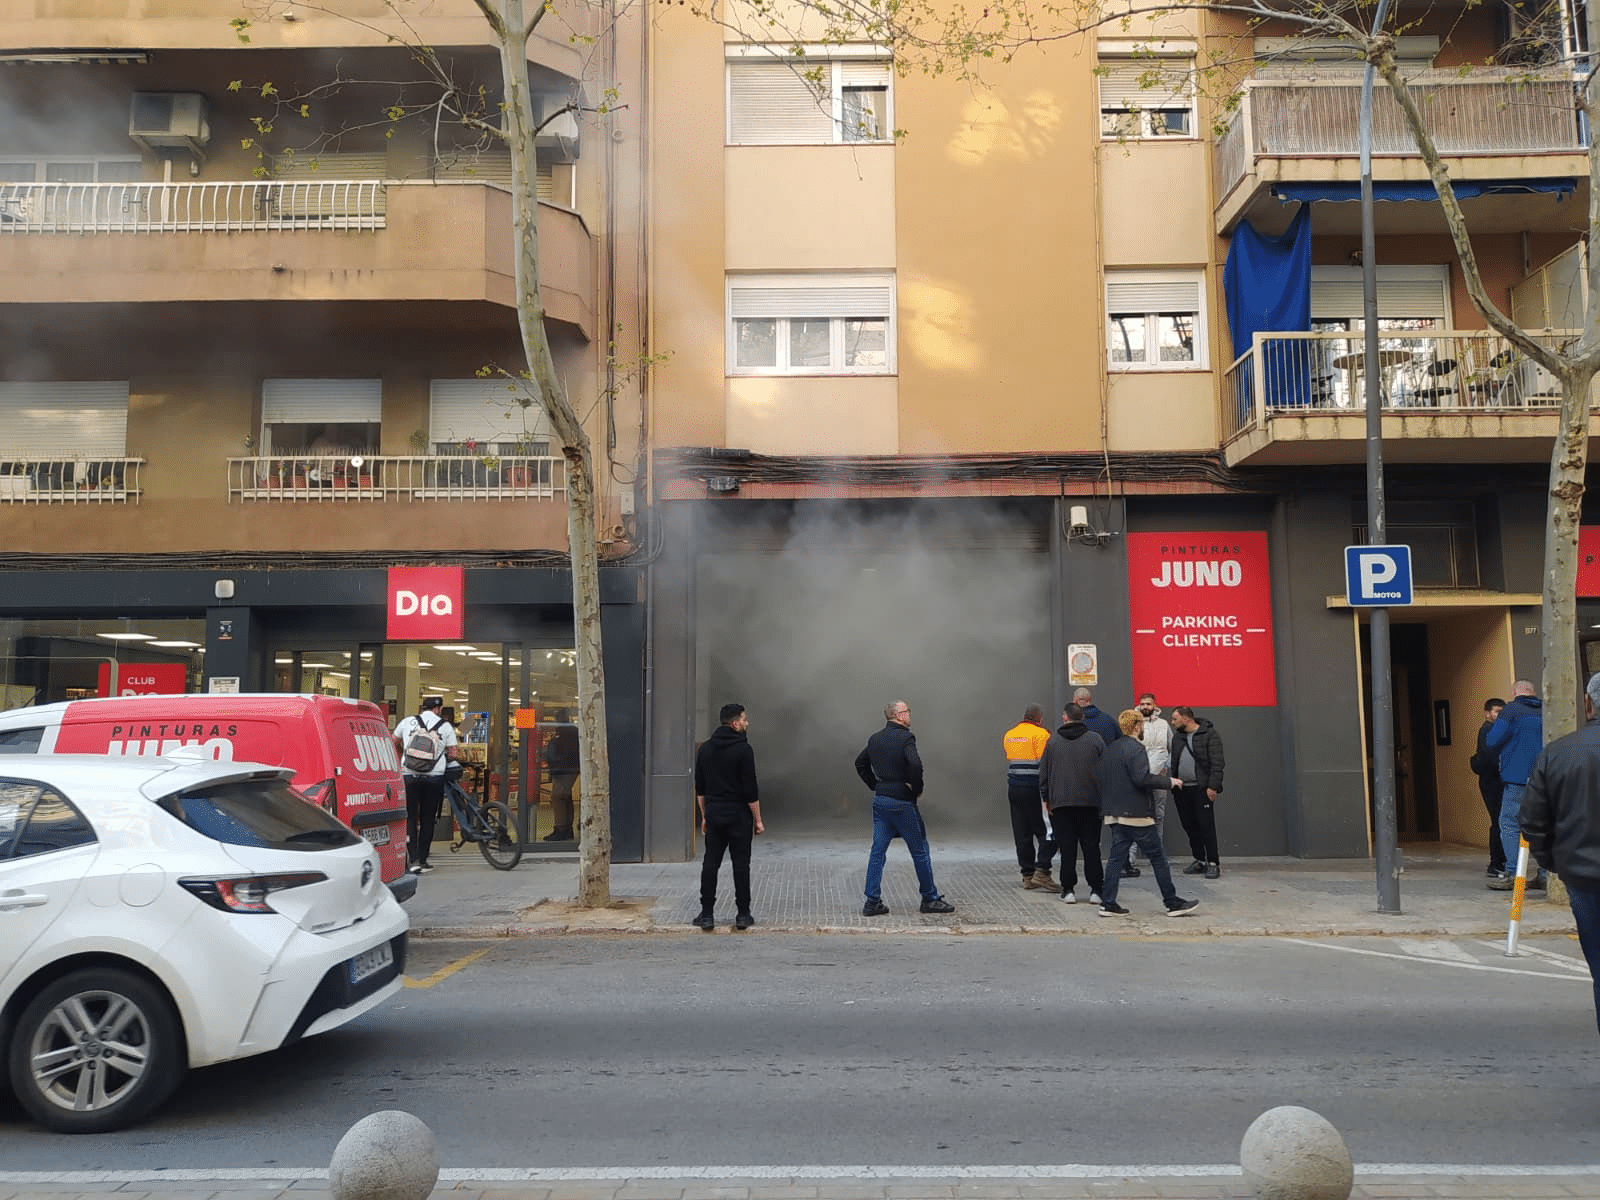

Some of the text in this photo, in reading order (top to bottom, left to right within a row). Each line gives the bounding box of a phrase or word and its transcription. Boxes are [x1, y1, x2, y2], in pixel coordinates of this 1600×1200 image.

[1161, 546, 1240, 554] PINTURAS
[1151, 560, 1242, 587] JUNO
[1359, 554, 1397, 598] P
[396, 590, 453, 616] Dia
[1162, 615, 1238, 628] PARKING
[1162, 634, 1242, 647] CLIENTES
[127, 676, 156, 685] CLUB
[112, 724, 238, 738] PINTURAS
